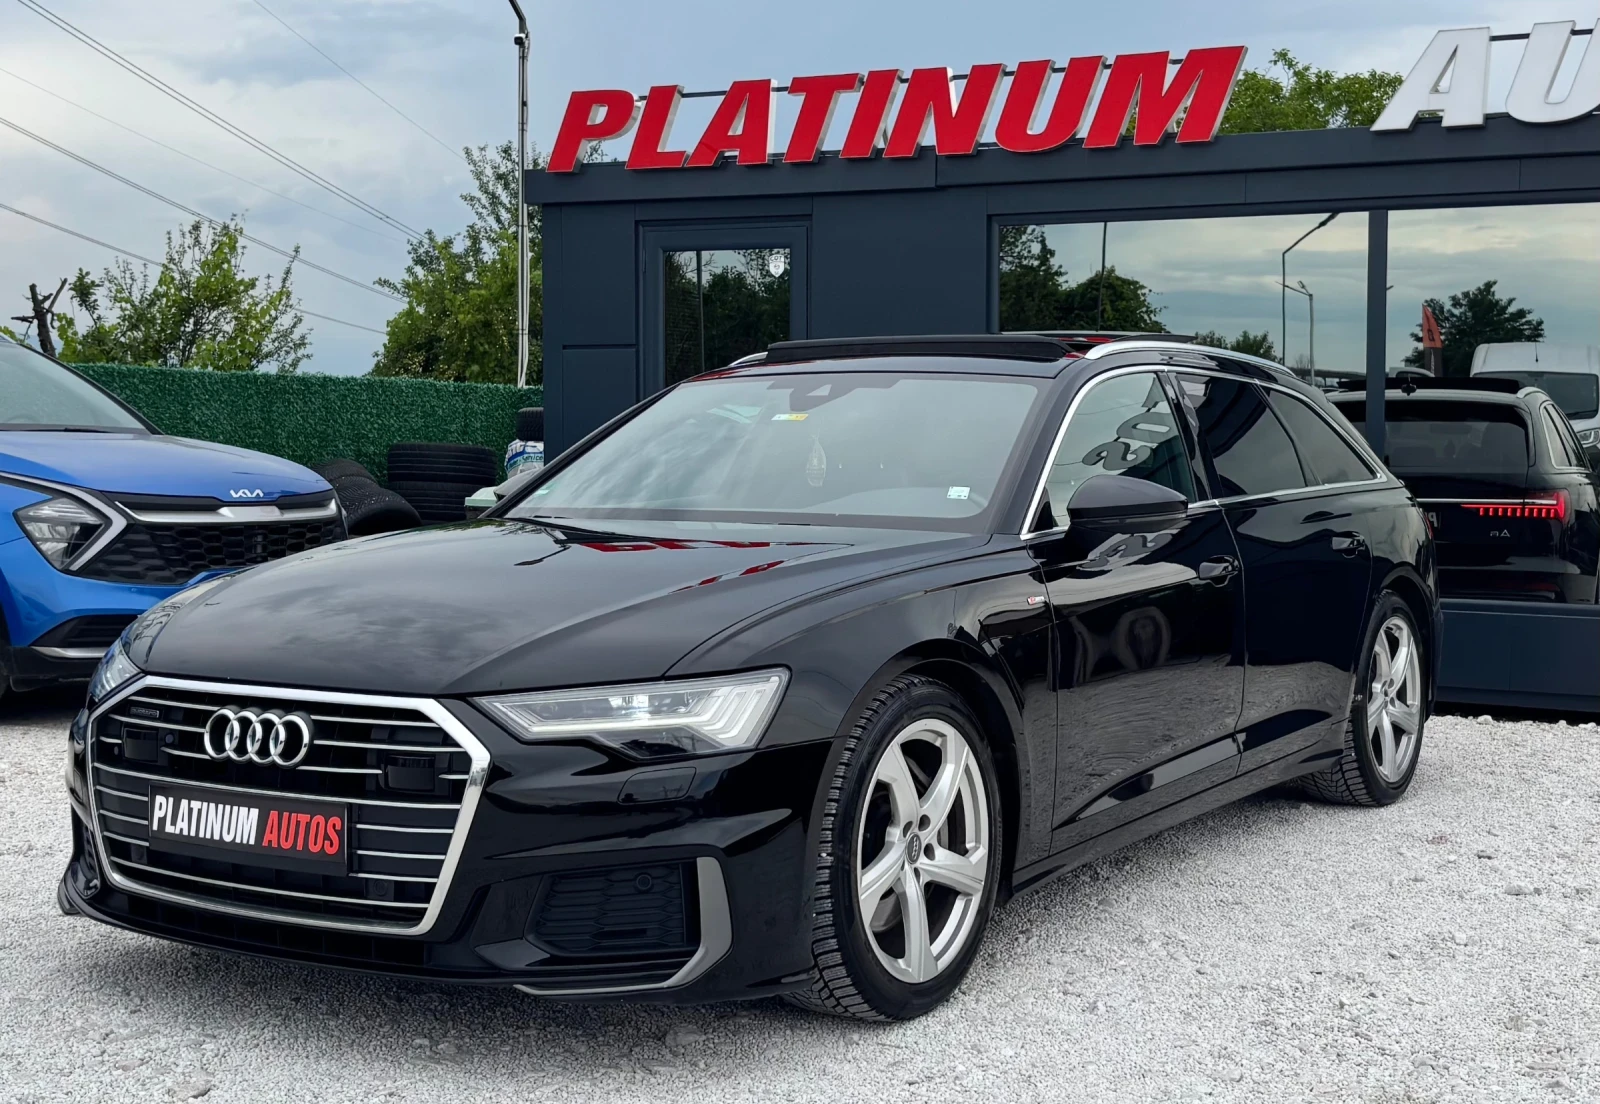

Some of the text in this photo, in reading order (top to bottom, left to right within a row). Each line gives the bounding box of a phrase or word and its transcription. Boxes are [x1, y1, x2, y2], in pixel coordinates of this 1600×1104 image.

[546, 46, 1246, 172] PLATINUM
[153, 795, 341, 854] PLATINUM AUTOS
